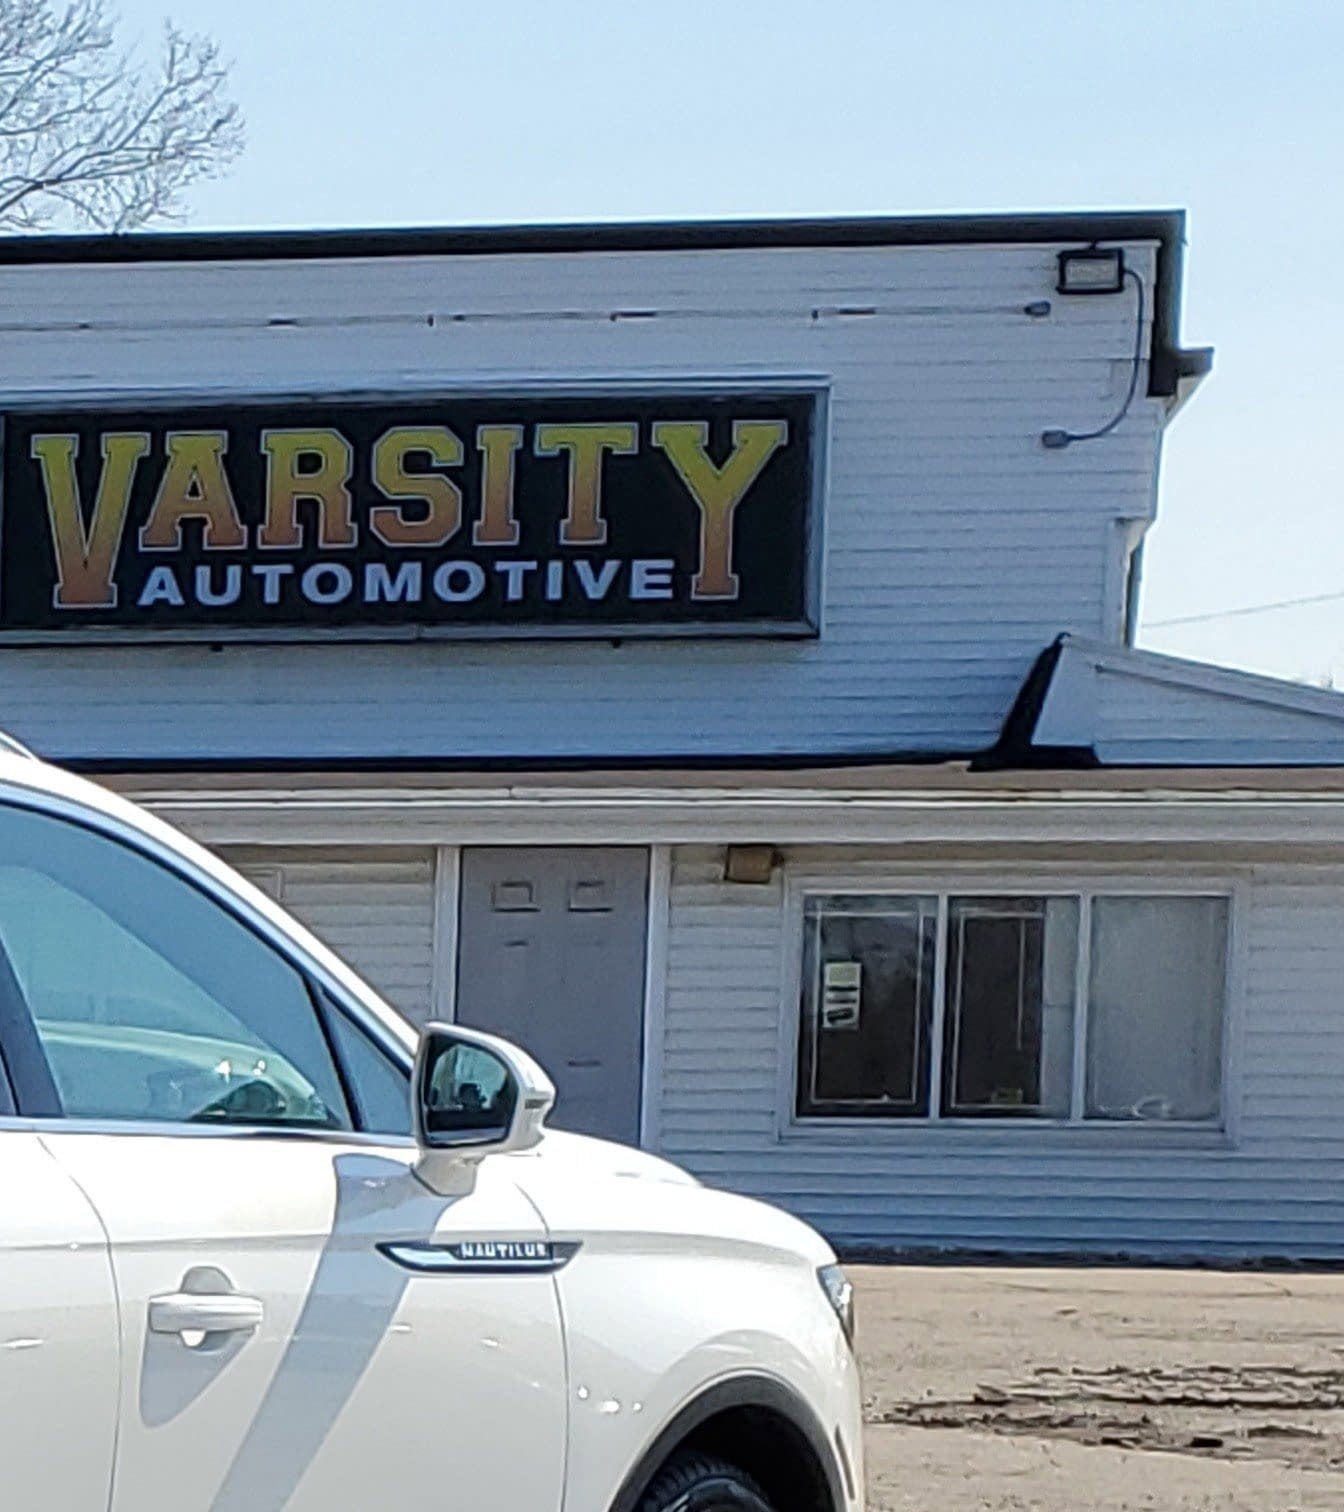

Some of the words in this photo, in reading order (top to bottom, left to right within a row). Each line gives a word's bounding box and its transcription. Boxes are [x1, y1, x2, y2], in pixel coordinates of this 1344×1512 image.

[31, 420, 788, 609] VARSITY
[137, 559, 676, 606] AUTOMOTIVE
[461, 1241, 546, 1258] NAUTILUS
